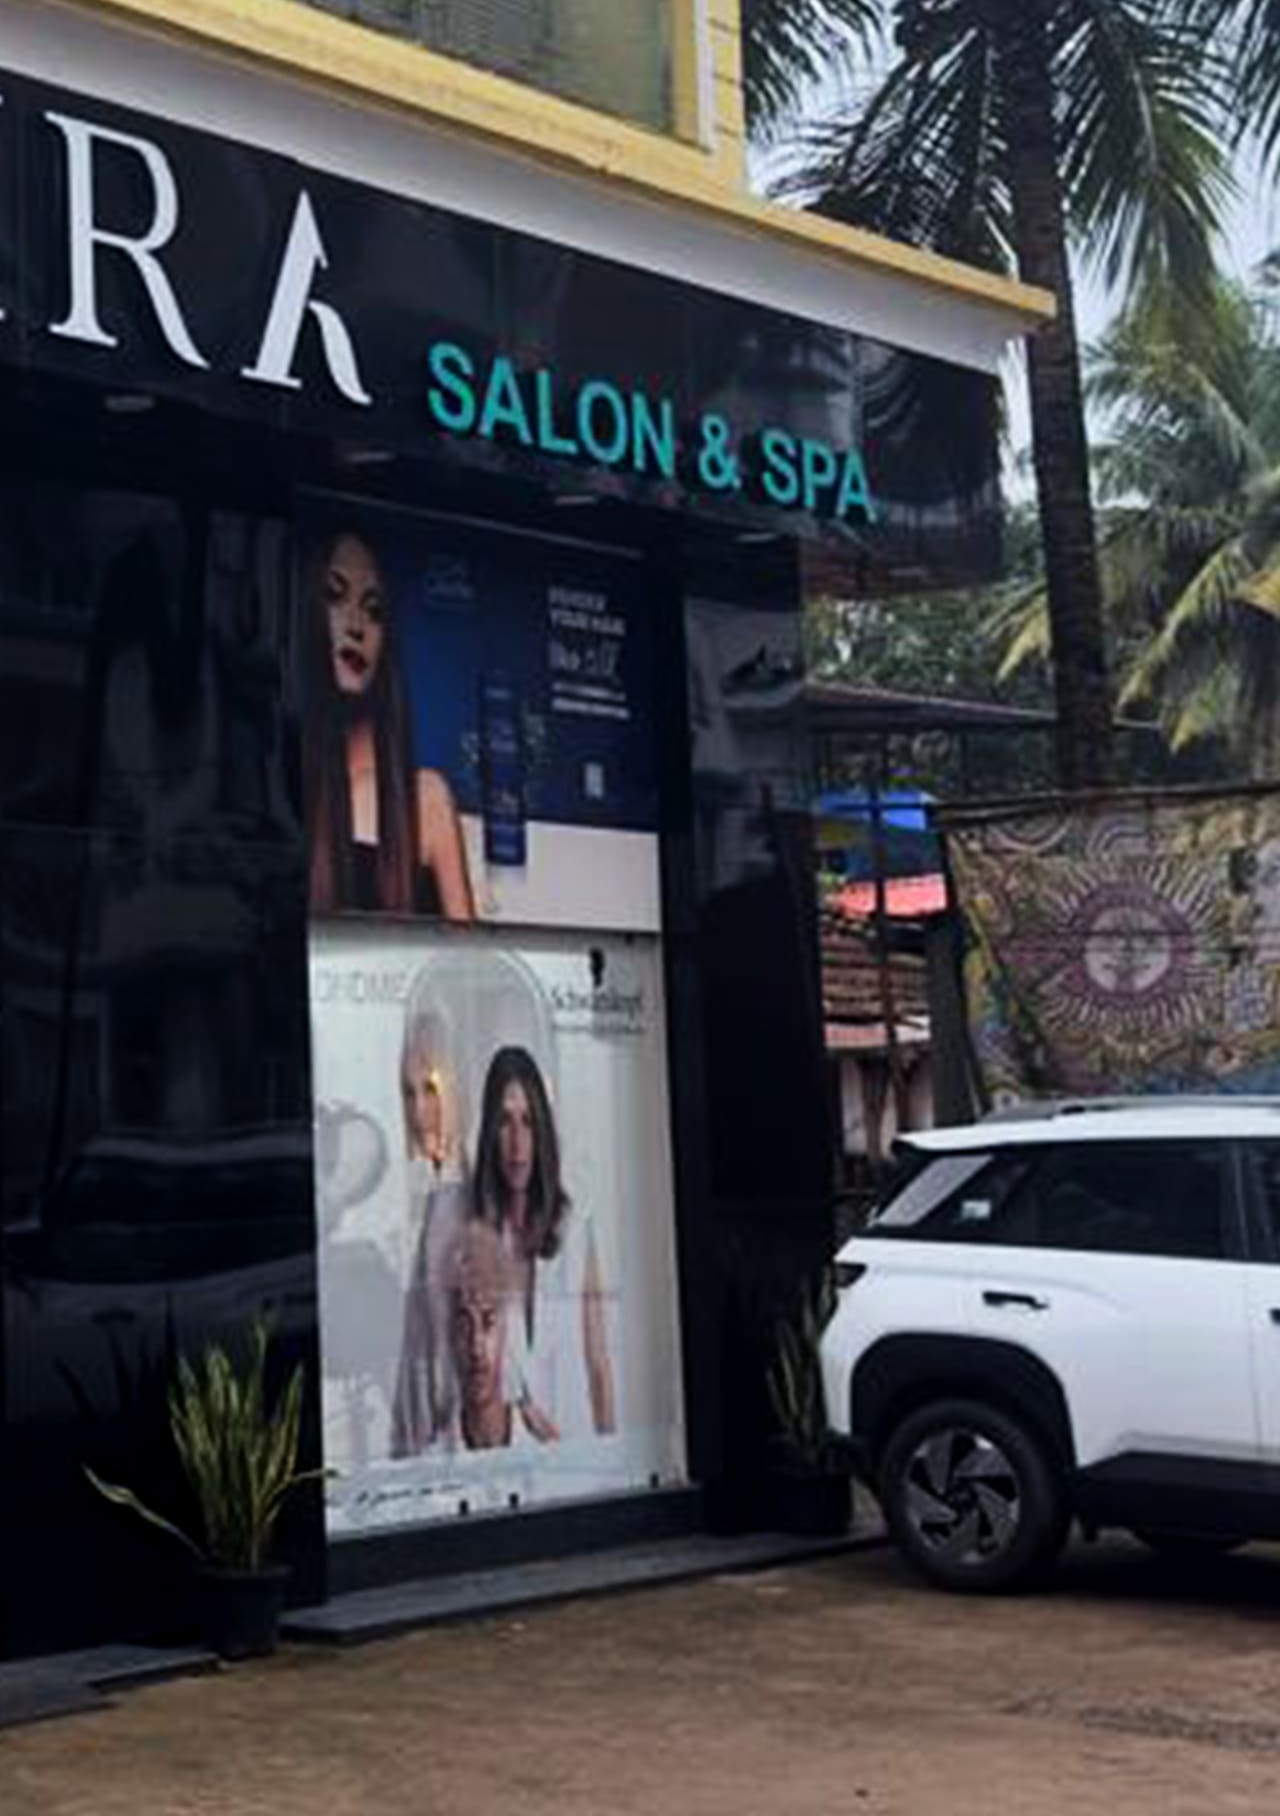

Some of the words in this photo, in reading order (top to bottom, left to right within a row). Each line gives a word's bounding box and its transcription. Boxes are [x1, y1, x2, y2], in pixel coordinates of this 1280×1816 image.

[426, 340, 676, 477] SALON
[697, 414, 742, 489] &
[761, 431, 878, 523] SPA
